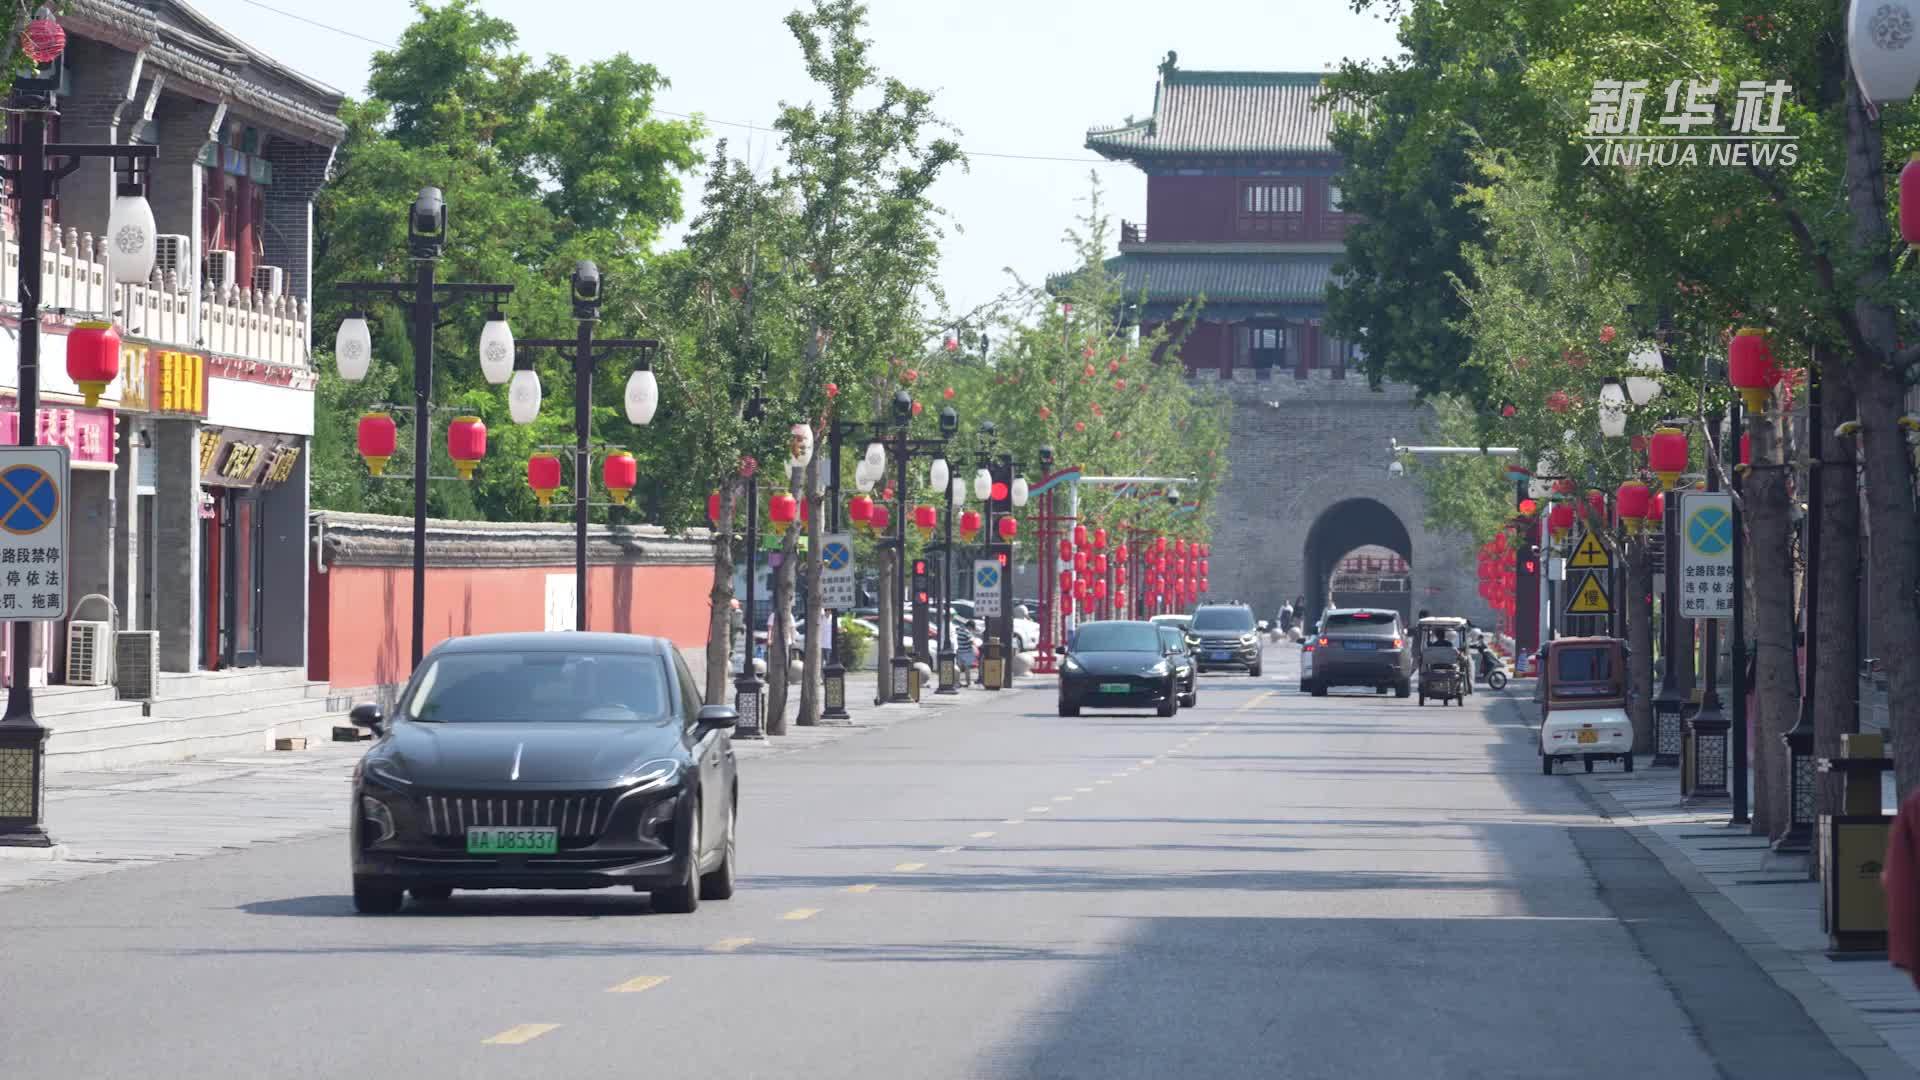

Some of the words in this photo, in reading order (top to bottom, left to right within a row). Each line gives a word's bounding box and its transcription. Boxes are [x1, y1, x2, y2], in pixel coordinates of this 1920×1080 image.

[0, 547, 60, 563] 路段禁停
[0, 570, 59, 587] 停依法
[0, 593, 60, 609] 罚、拖离
